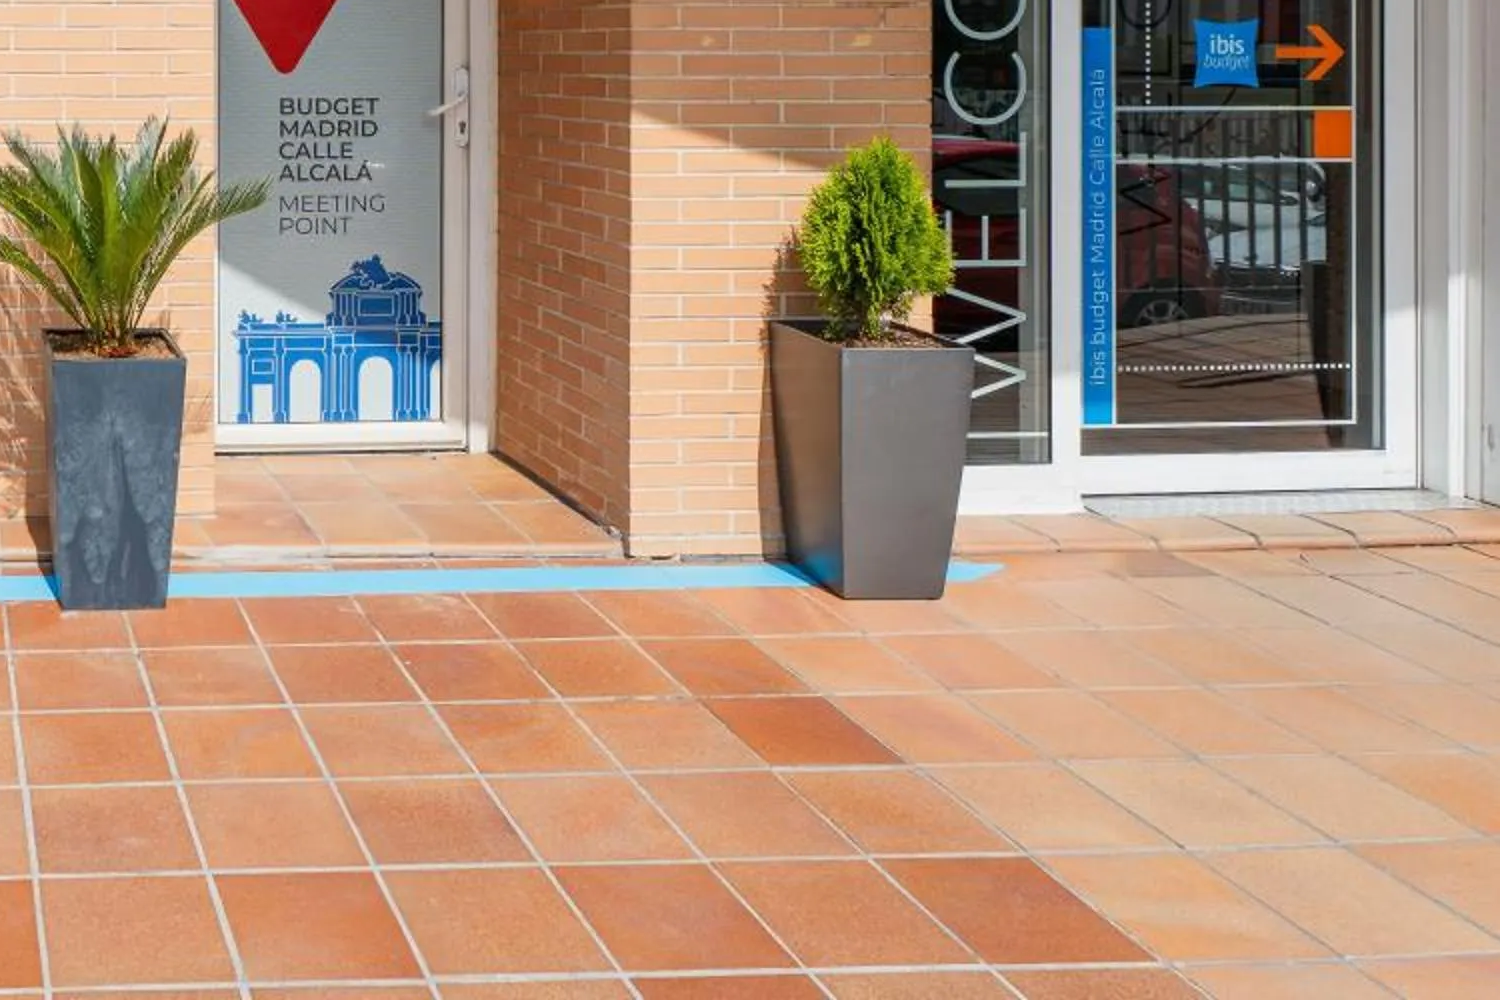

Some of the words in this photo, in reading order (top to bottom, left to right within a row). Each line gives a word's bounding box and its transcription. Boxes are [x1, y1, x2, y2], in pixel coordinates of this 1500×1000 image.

[1209, 33, 1245, 55] ibis
[279, 97, 380, 116] BUDGET
[279, 119, 379, 138] MADRID
[279, 141, 354, 160] CALLE
[1089, 134, 1106, 185] Calle
[279, 159, 373, 182] ALCALÁ
[279, 195, 386, 213] MEETING
[279, 216, 353, 236] POINT
[1089, 191, 1106, 263] Madrid
[1089, 270, 1109, 345] budget
[1089, 351, 1106, 386] ibis
